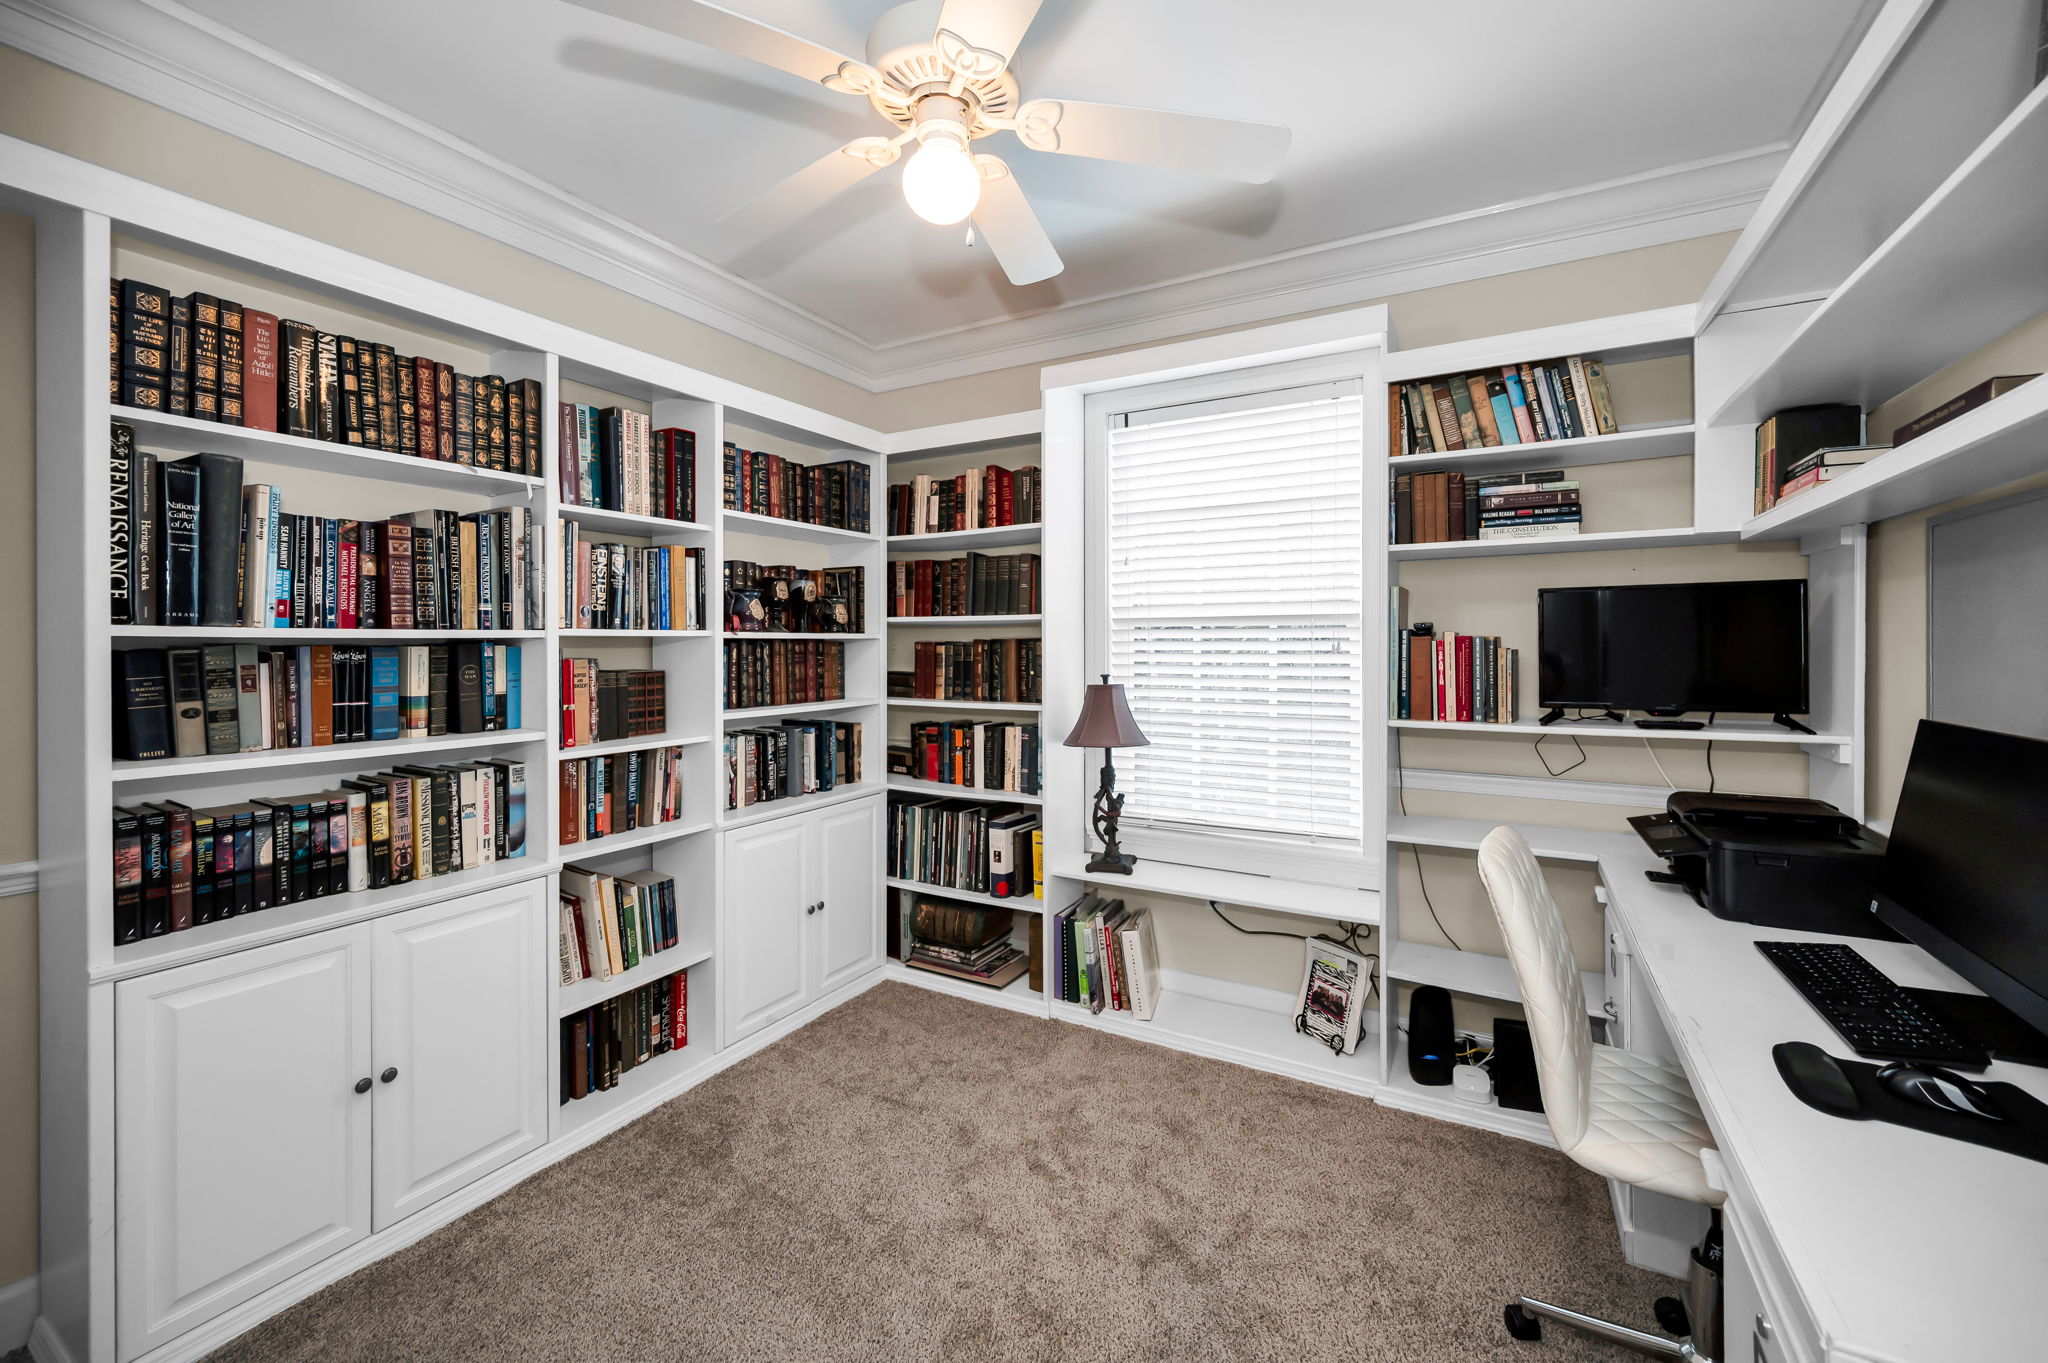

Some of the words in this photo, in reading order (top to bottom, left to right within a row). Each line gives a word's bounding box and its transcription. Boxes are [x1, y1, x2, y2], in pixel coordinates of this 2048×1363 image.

[134, 314, 148, 322] THE
[149, 317, 163, 326] LIFE
[132, 330, 164, 340] MAYNARD
[256, 328, 270, 336] The
[254, 347, 272, 356] Death
[252, 360, 274, 369] Adolf
[318, 332, 338, 386] STALIN
[252, 367, 274, 378] Hitler
[302, 336, 315, 402] Khrushchev
[288, 345, 302, 410] Remembers
[166, 500, 200, 512] National
[168, 510, 198, 521] Gallery
[111, 459, 128, 600] RENAISSANCE
[182, 521, 195, 530] Art
[1505, 525, 1558, 533] CONSTITUTION
[140, 520, 151, 552] Heritage
[280, 544, 288, 568] HANNITY
[141, 555, 150, 572] Cook
[141, 574, 150, 590] Book
[597, 549, 607, 604] EINSTEIN
[282, 590, 288, 598] US
[296, 583, 305, 595] NEIL
[328, 582, 334, 592] AT
[396, 782, 408, 795] DAN
[396, 796, 408, 819] BROWN
[421, 785, 431, 822] MESSIANIC
[372, 807, 383, 836] MARK
[398, 825, 408, 833] LOST
[421, 822, 431, 849] LEGACY
[152, 833, 161, 879] ARMAGEDDON
[662, 995, 671, 1044] SPYCATCHER
